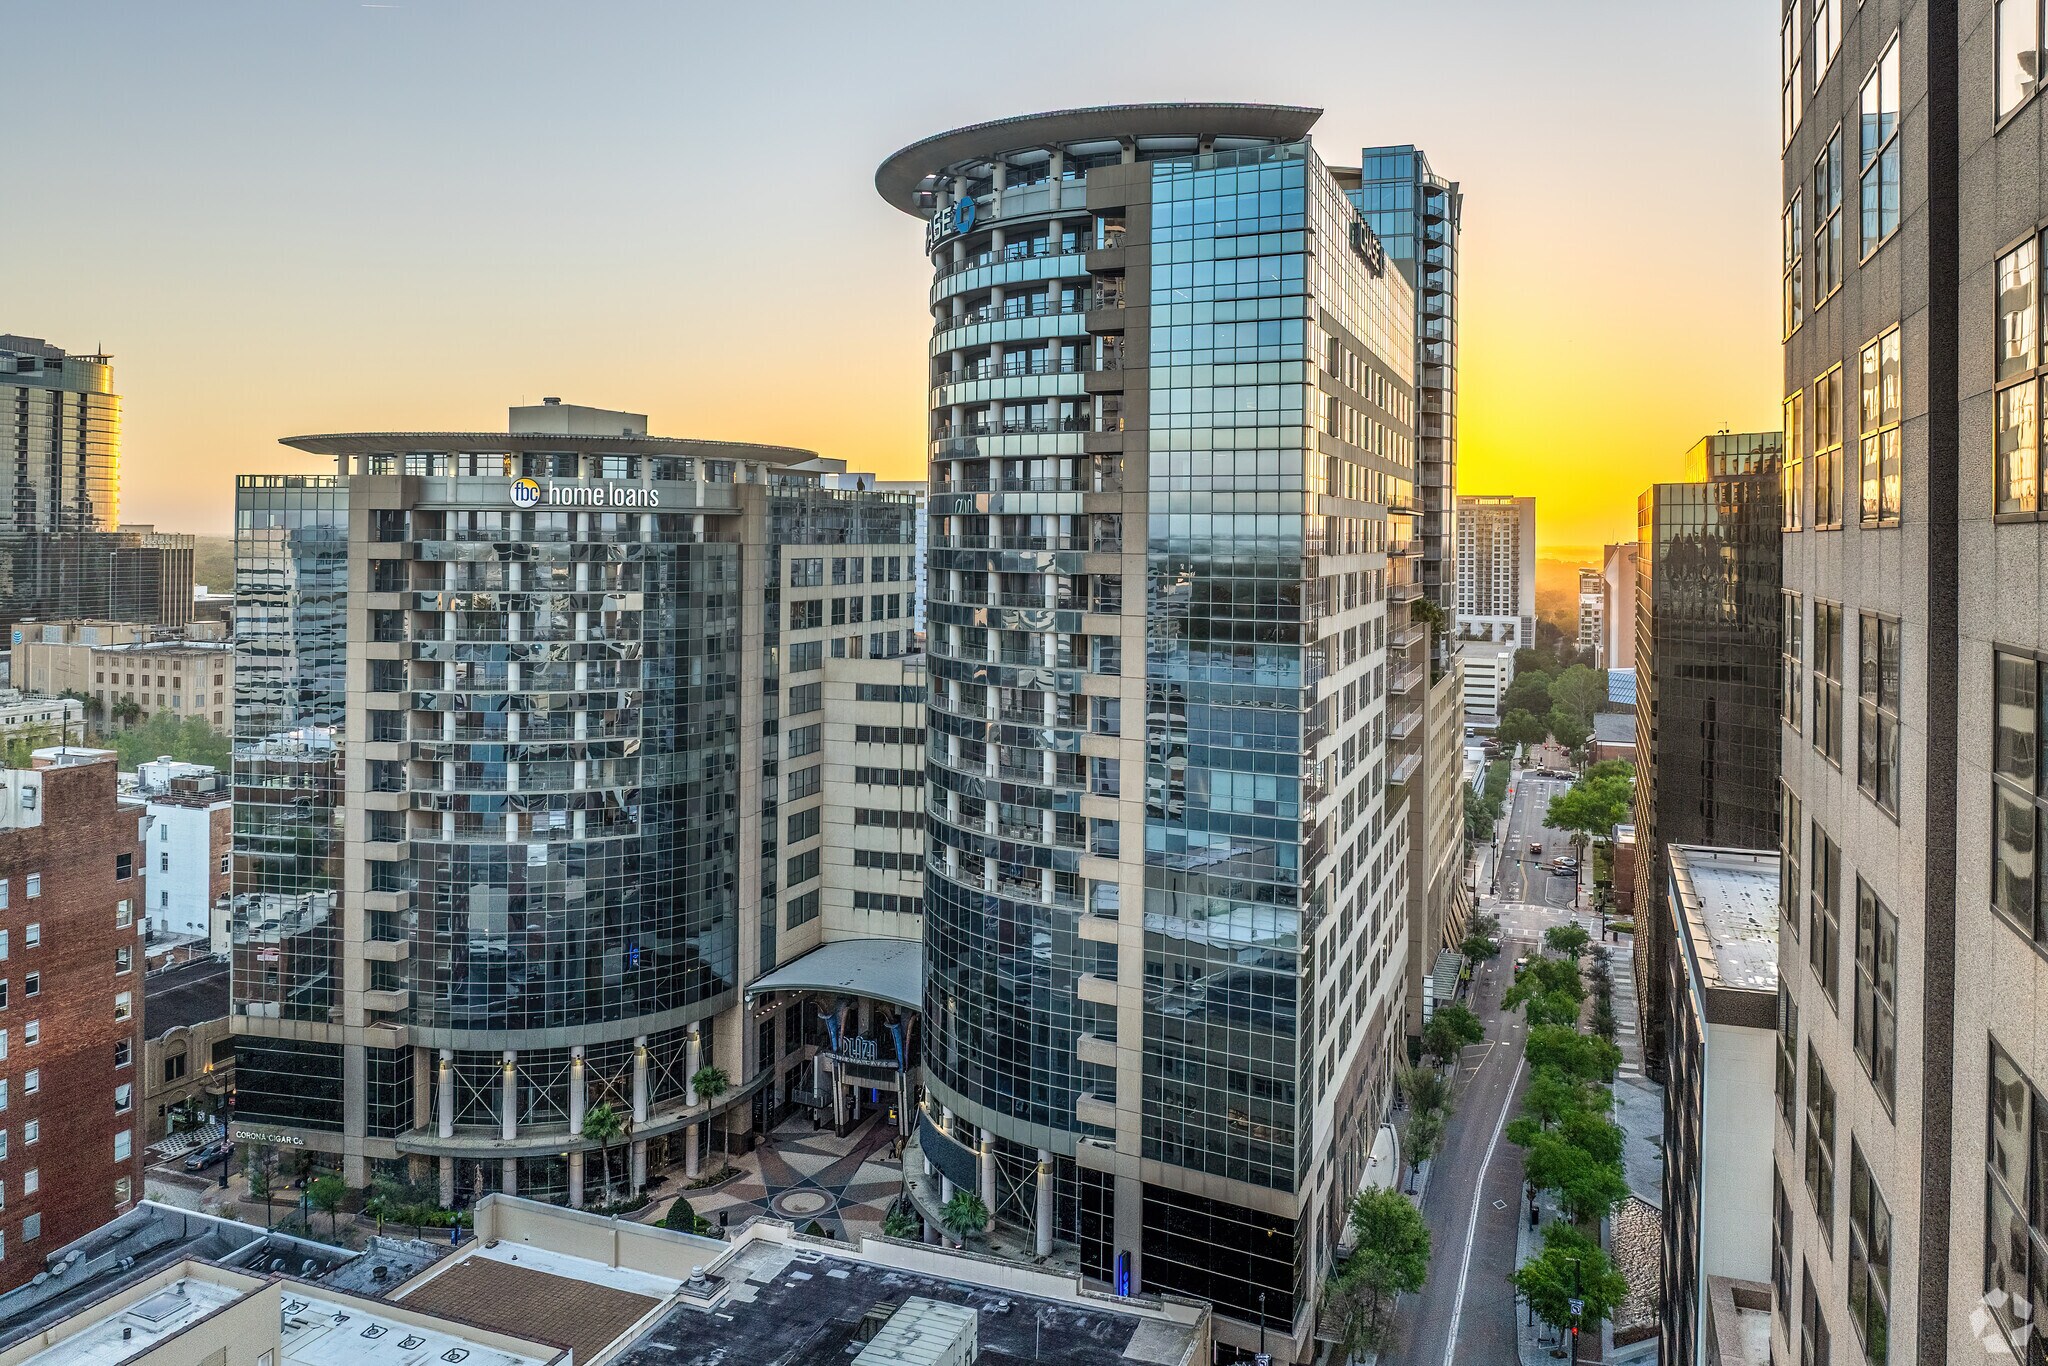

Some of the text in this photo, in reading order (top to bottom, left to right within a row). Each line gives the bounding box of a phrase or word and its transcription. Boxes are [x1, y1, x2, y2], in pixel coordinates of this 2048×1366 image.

[514, 481, 538, 501] fbc
[549, 480, 659, 507] home loans
[843, 1036, 877, 1060] PLAZA
[235, 1130, 266, 1141] CORONA
[268, 1134, 292, 1144] CIGAR
